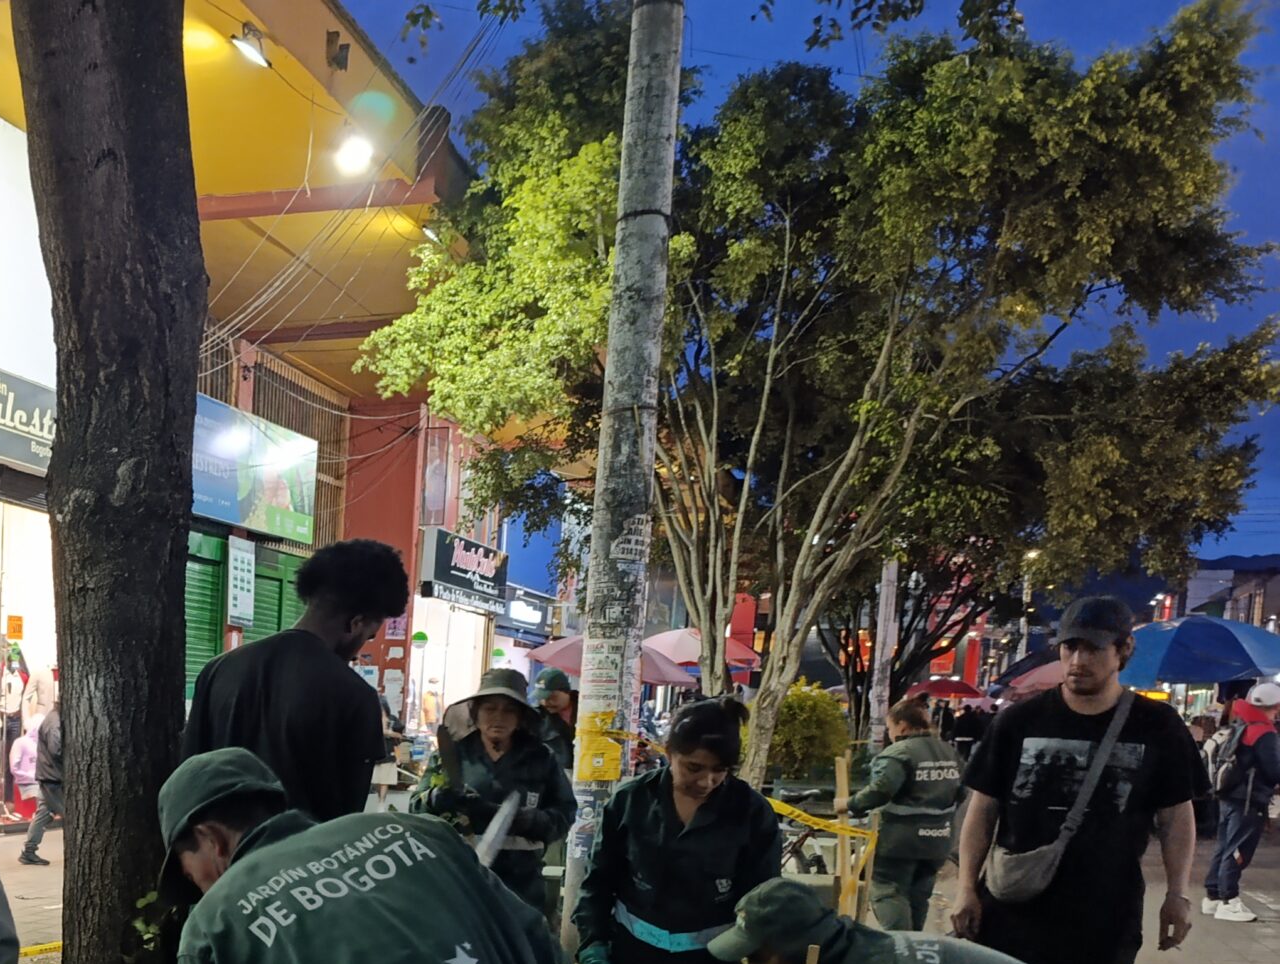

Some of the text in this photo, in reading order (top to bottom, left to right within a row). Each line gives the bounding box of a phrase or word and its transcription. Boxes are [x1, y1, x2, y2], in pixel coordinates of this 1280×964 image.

[237, 823, 404, 915] JARDÍN BOTÁNICO
[248, 831, 437, 948] DE BOGOTÁ
